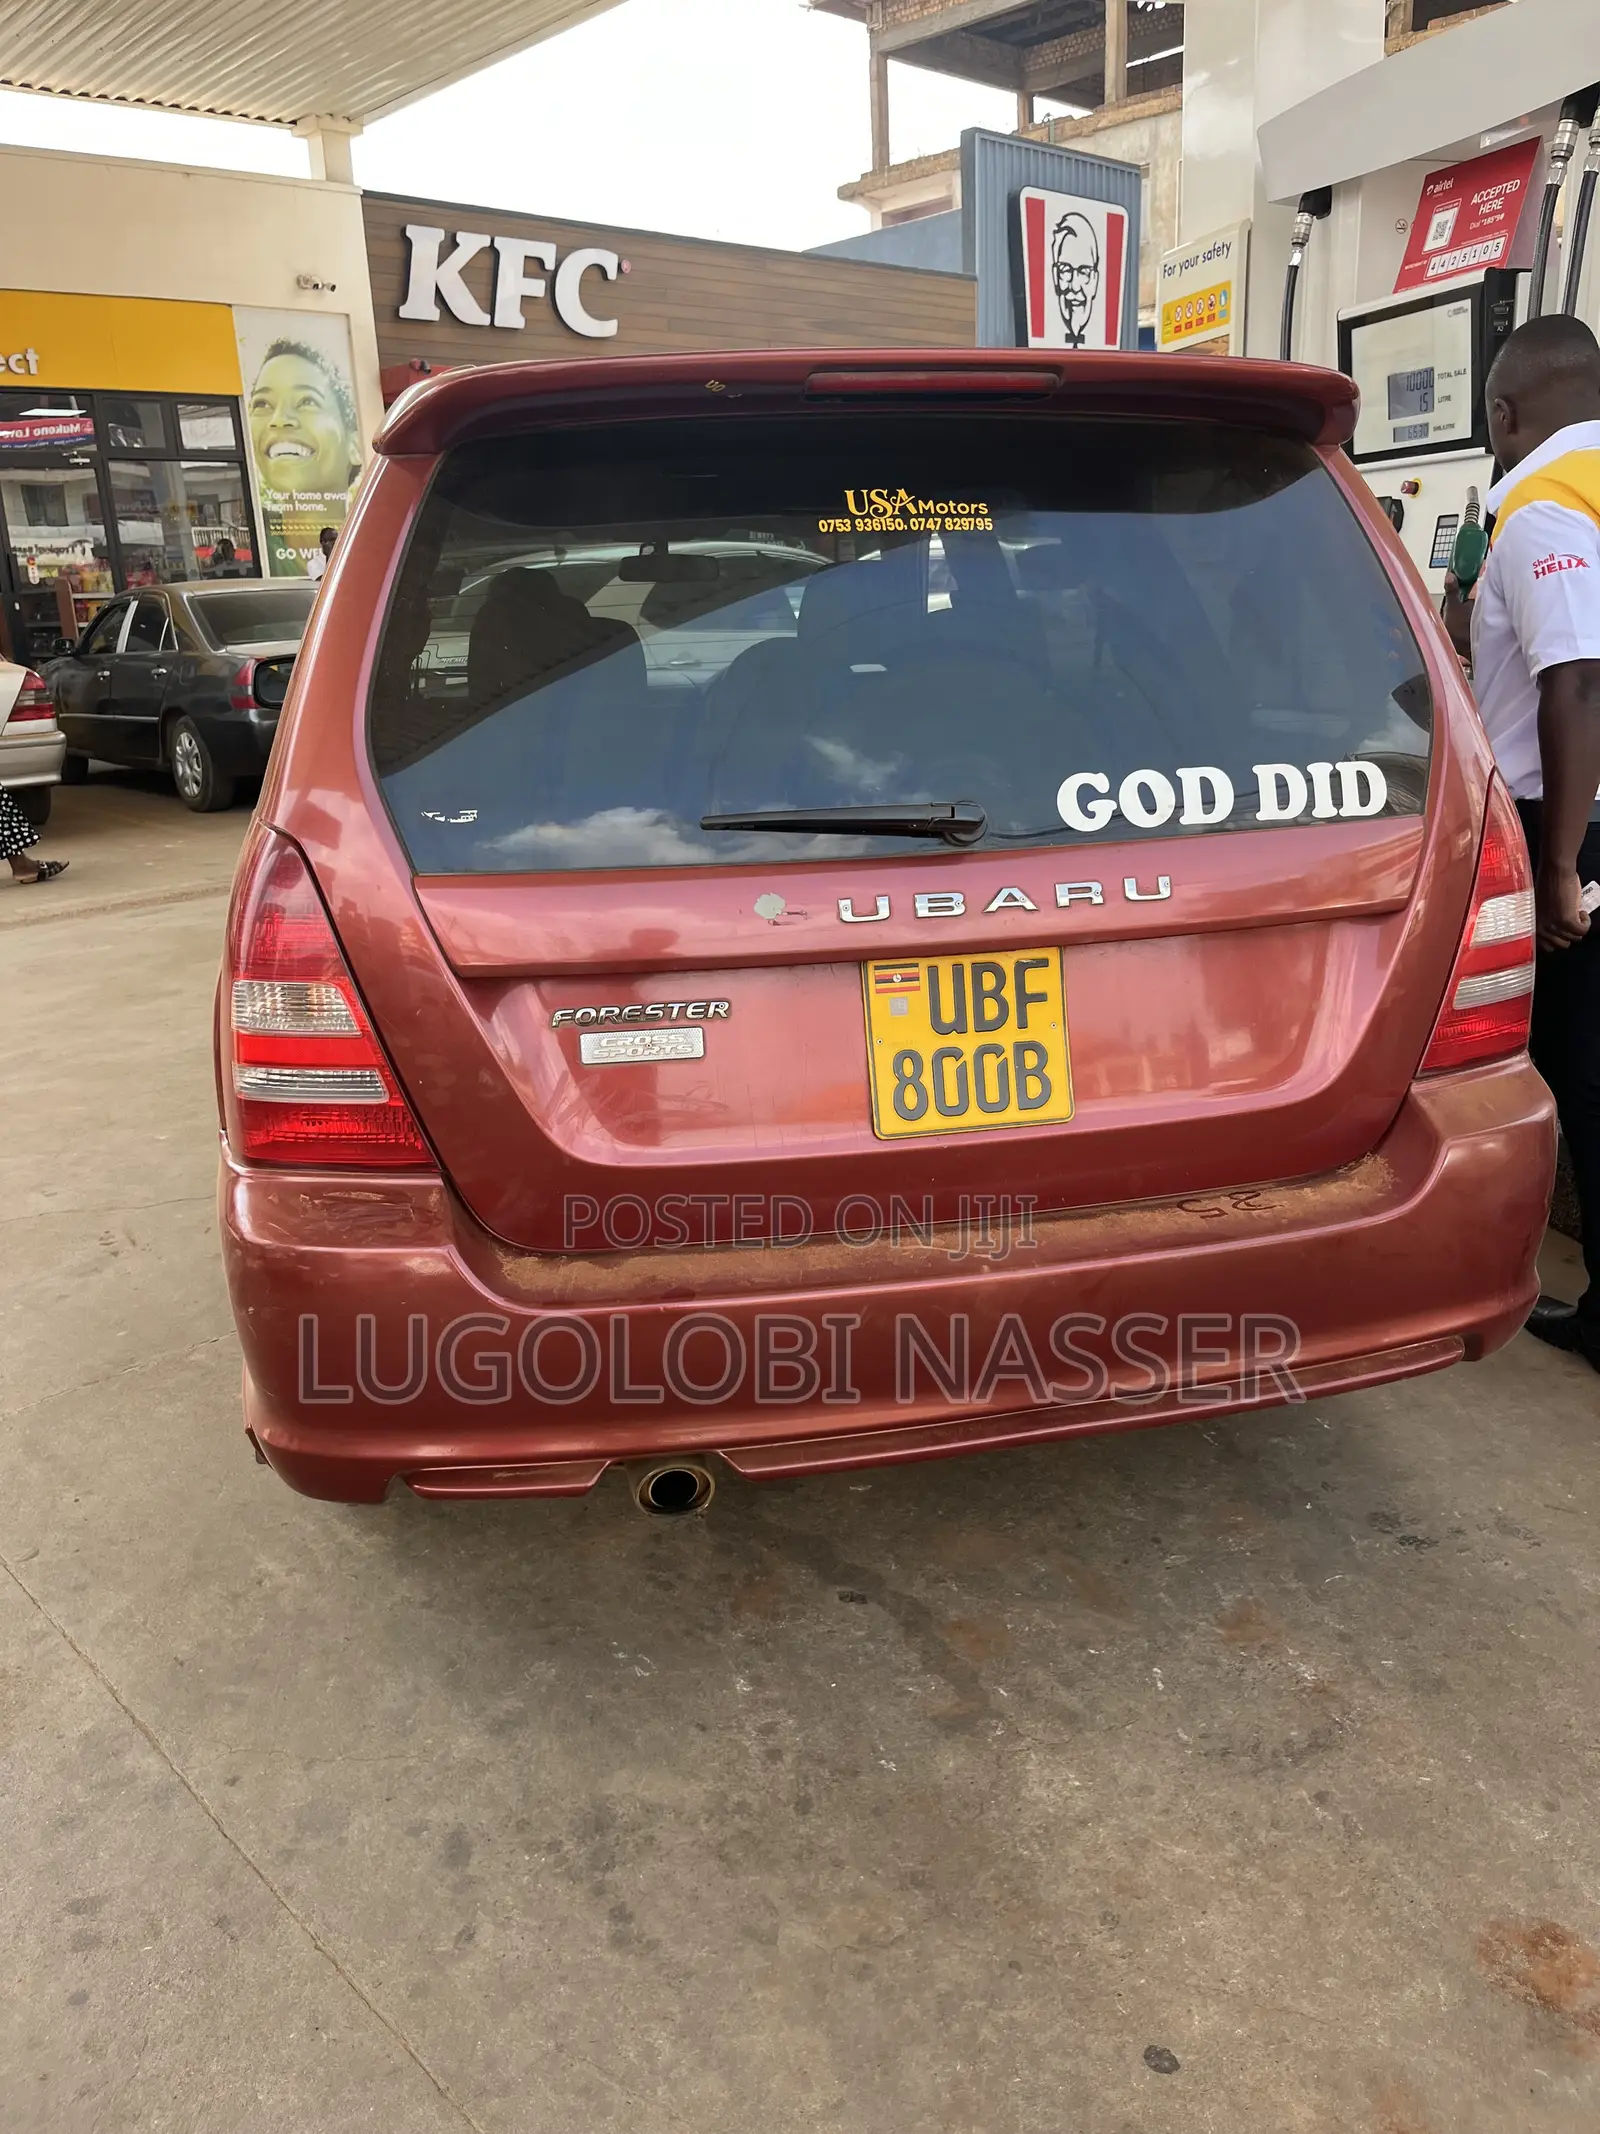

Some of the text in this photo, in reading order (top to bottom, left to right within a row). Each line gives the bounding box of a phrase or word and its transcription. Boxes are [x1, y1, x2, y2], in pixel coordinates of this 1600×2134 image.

[1434, 177, 1454, 193] airtel
[1471, 179, 1521, 206] ACCEPTED
[1478, 197, 1505, 216] HERE
[1470, 220, 1481, 230] Dial
[1163, 240, 1232, 279] For your safety
[398, 224, 619, 338] KFC
[1406, 368, 1434, 392] 10000
[1437, 367, 1467, 381] TOTAL SALE
[1438, 395, 1452, 404] LITRE
[1407, 424, 1429, 440] 6630
[266, 488, 350, 501] Your home awa
[844, 488, 988, 519] USA Motors
[294, 501, 328, 512] home.
[818, 518, 851, 533] 0753
[910, 518, 942, 531] 0747
[945, 518, 993, 531] 829795
[275, 548, 324, 560] GO WE
[1532, 553, 1555, 569] Shell
[1534, 556, 1589, 580] HELIX
[1056, 760, 1388, 832] GOD DID
[837, 875, 1172, 923] UBARU
[927, 957, 1050, 1036] UBF
[552, 1000, 731, 1028] FORESTER
[599, 1033, 686, 1048] CROSS
[592, 1043, 695, 1060] SPORTS
[892, 1040, 1052, 1121] 800B
